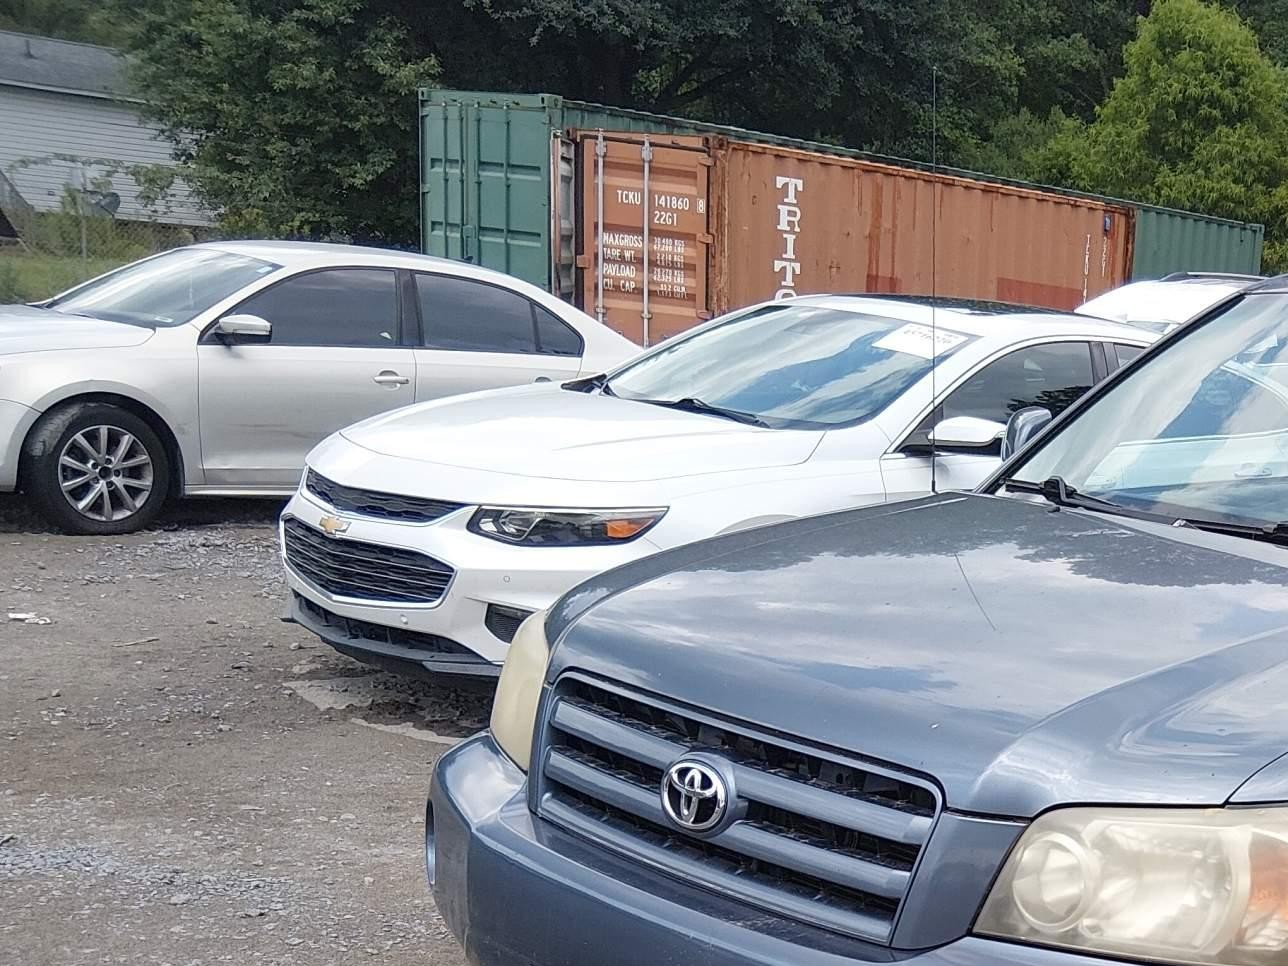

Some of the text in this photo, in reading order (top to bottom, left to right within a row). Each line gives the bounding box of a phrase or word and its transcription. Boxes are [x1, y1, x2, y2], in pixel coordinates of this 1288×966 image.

[616, 190, 706, 213] TCKU 141860 8
[653, 211, 678, 226] 22G1
[603, 232, 643, 247] MAXGROSS
[603, 247, 622, 261] TARE
[603, 262, 636, 278] PAYLOAD
